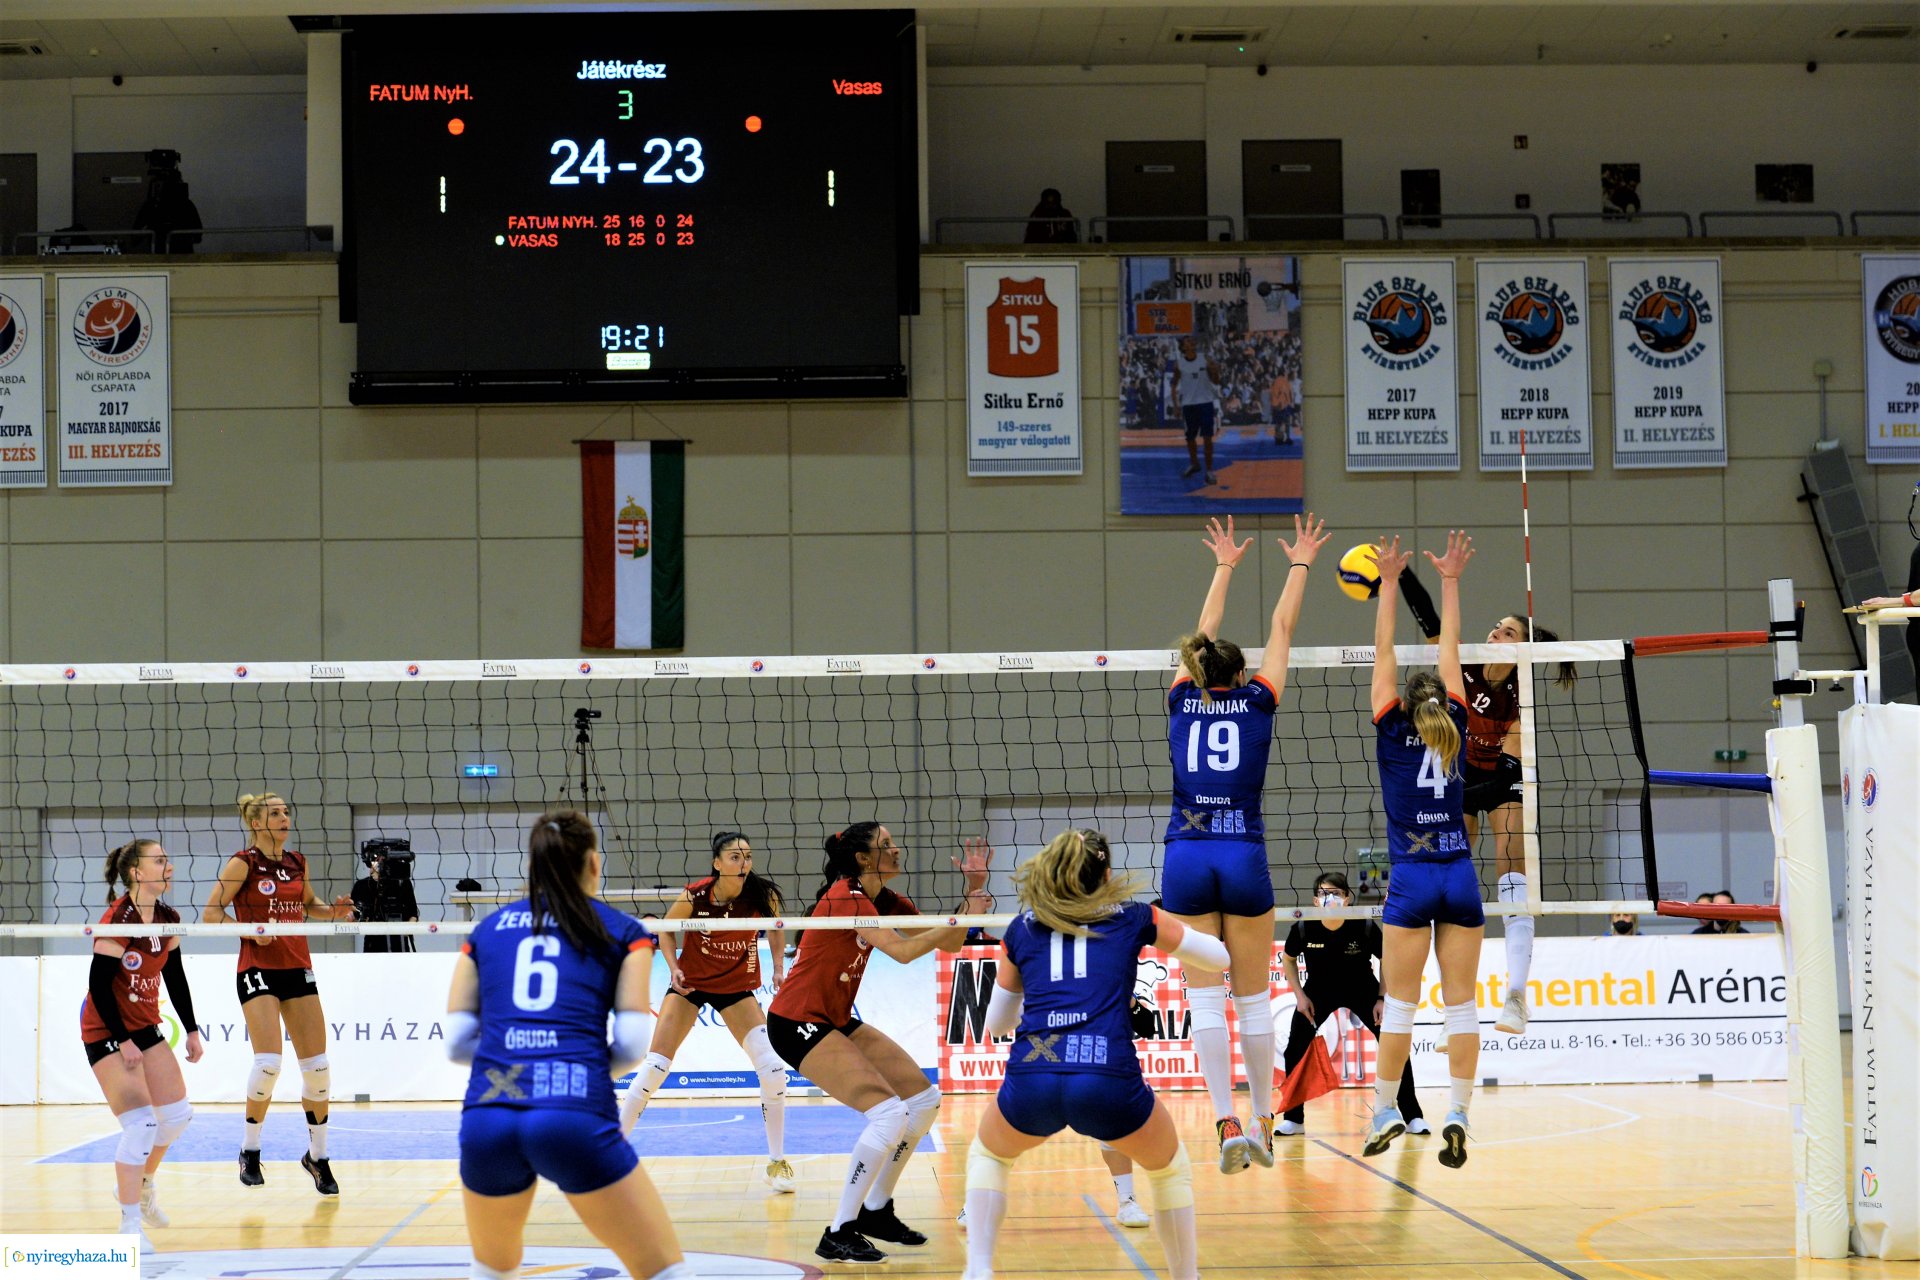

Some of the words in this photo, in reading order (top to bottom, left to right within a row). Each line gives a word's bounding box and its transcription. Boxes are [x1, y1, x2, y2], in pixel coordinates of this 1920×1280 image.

[577, 60, 667, 82] Játékrész
[370, 85, 430, 102] FATUM
[433, 85, 474, 104] NyH.
[832, 79, 883, 96] Vasas
[618, 90, 633, 120] 3
[508, 215, 559, 229] FATUM
[563, 215, 598, 228] NYH.
[603, 213, 621, 228] 25
[628, 213, 645, 228] 16
[656, 213, 666, 228] 0
[677, 213, 694, 228] 24
[508, 233, 559, 248] VASAS
[604, 233, 621, 247] 18
[628, 232, 645, 247] 25
[656, 232, 666, 246] 0
[677, 232, 694, 246] 23
[1174, 271, 1213, 291] SITKU
[1218, 268, 1252, 289] ERNŐ
[78, 288, 128, 319] FATUM
[1001, 294, 1043, 306] SITKU
[1353, 278, 1387, 323] BLUE
[1485, 277, 1520, 323] BLUE
[1619, 277, 1653, 322] BLUE
[601, 324, 664, 351] 19:21
[1004, 315, 1041, 355] 15
[91, 383, 136, 393] CSAPATA
[1386, 388, 1416, 402] 2017
[1520, 388, 1550, 402] 2018
[1653, 386, 1684, 401] 2019
[100, 402, 129, 416] 2017
[984, 392, 1024, 410] Sitku
[1027, 391, 1065, 409] Ernő
[1888, 402, 1920, 414] HEPP
[1367, 408, 1400, 421] HEPP
[1403, 407, 1436, 420] KUPA
[1501, 408, 1534, 421] HEPP
[1537, 407, 1569, 420] KUPA
[1634, 406, 1667, 419] HEPP
[1670, 405, 1703, 418] KUPA
[68, 421, 108, 435] MAGYAR
[109, 417, 161, 434] BAJNOKSÁG
[997, 420, 1052, 434] 149-szeres
[1356, 431, 1373, 445] III.
[1375, 424, 1449, 445] HELYEZÉS
[1489, 431, 1505, 445] II.
[1508, 424, 1582, 445] HELYEZÉS
[1623, 429, 1639, 443] II.
[1642, 422, 1715, 442] HELYEZÉS
[68, 445, 88, 460] III.
[91, 439, 162, 459] HELYEZÉS
[978, 436, 1018, 448] magyar
[1020, 432, 1071, 448] válogatott
[0, 442, 36, 463] EZÉS
[1472, 692, 1491, 714] 12
[1187, 720, 1240, 773] 19
[1417, 746, 1448, 799] 4
[1417, 811, 1450, 824] ÓBUDA
[1051, 924, 1088, 982] 11
[244, 971, 269, 995] 11
[512, 934, 561, 1012] 6
[1417, 970, 1656, 1009] ontnental
[1668, 968, 1787, 1004] Aréna
[505, 1026, 558, 1050] ÓBUDA
[797, 1022, 819, 1041] 14
[1507, 1036, 1546, 1050] Géza
[1551, 1038, 1565, 1049] u.
[1569, 1034, 1608, 1049] 8-16.
[1622, 1033, 1651, 1048] Tel.:
[1655, 1032, 1685, 1047] +36
[1691, 1032, 1711, 1046] 30
[1716, 1031, 1747, 1046] 586
[690, 1076, 746, 1084] www.hunvolley.hu
